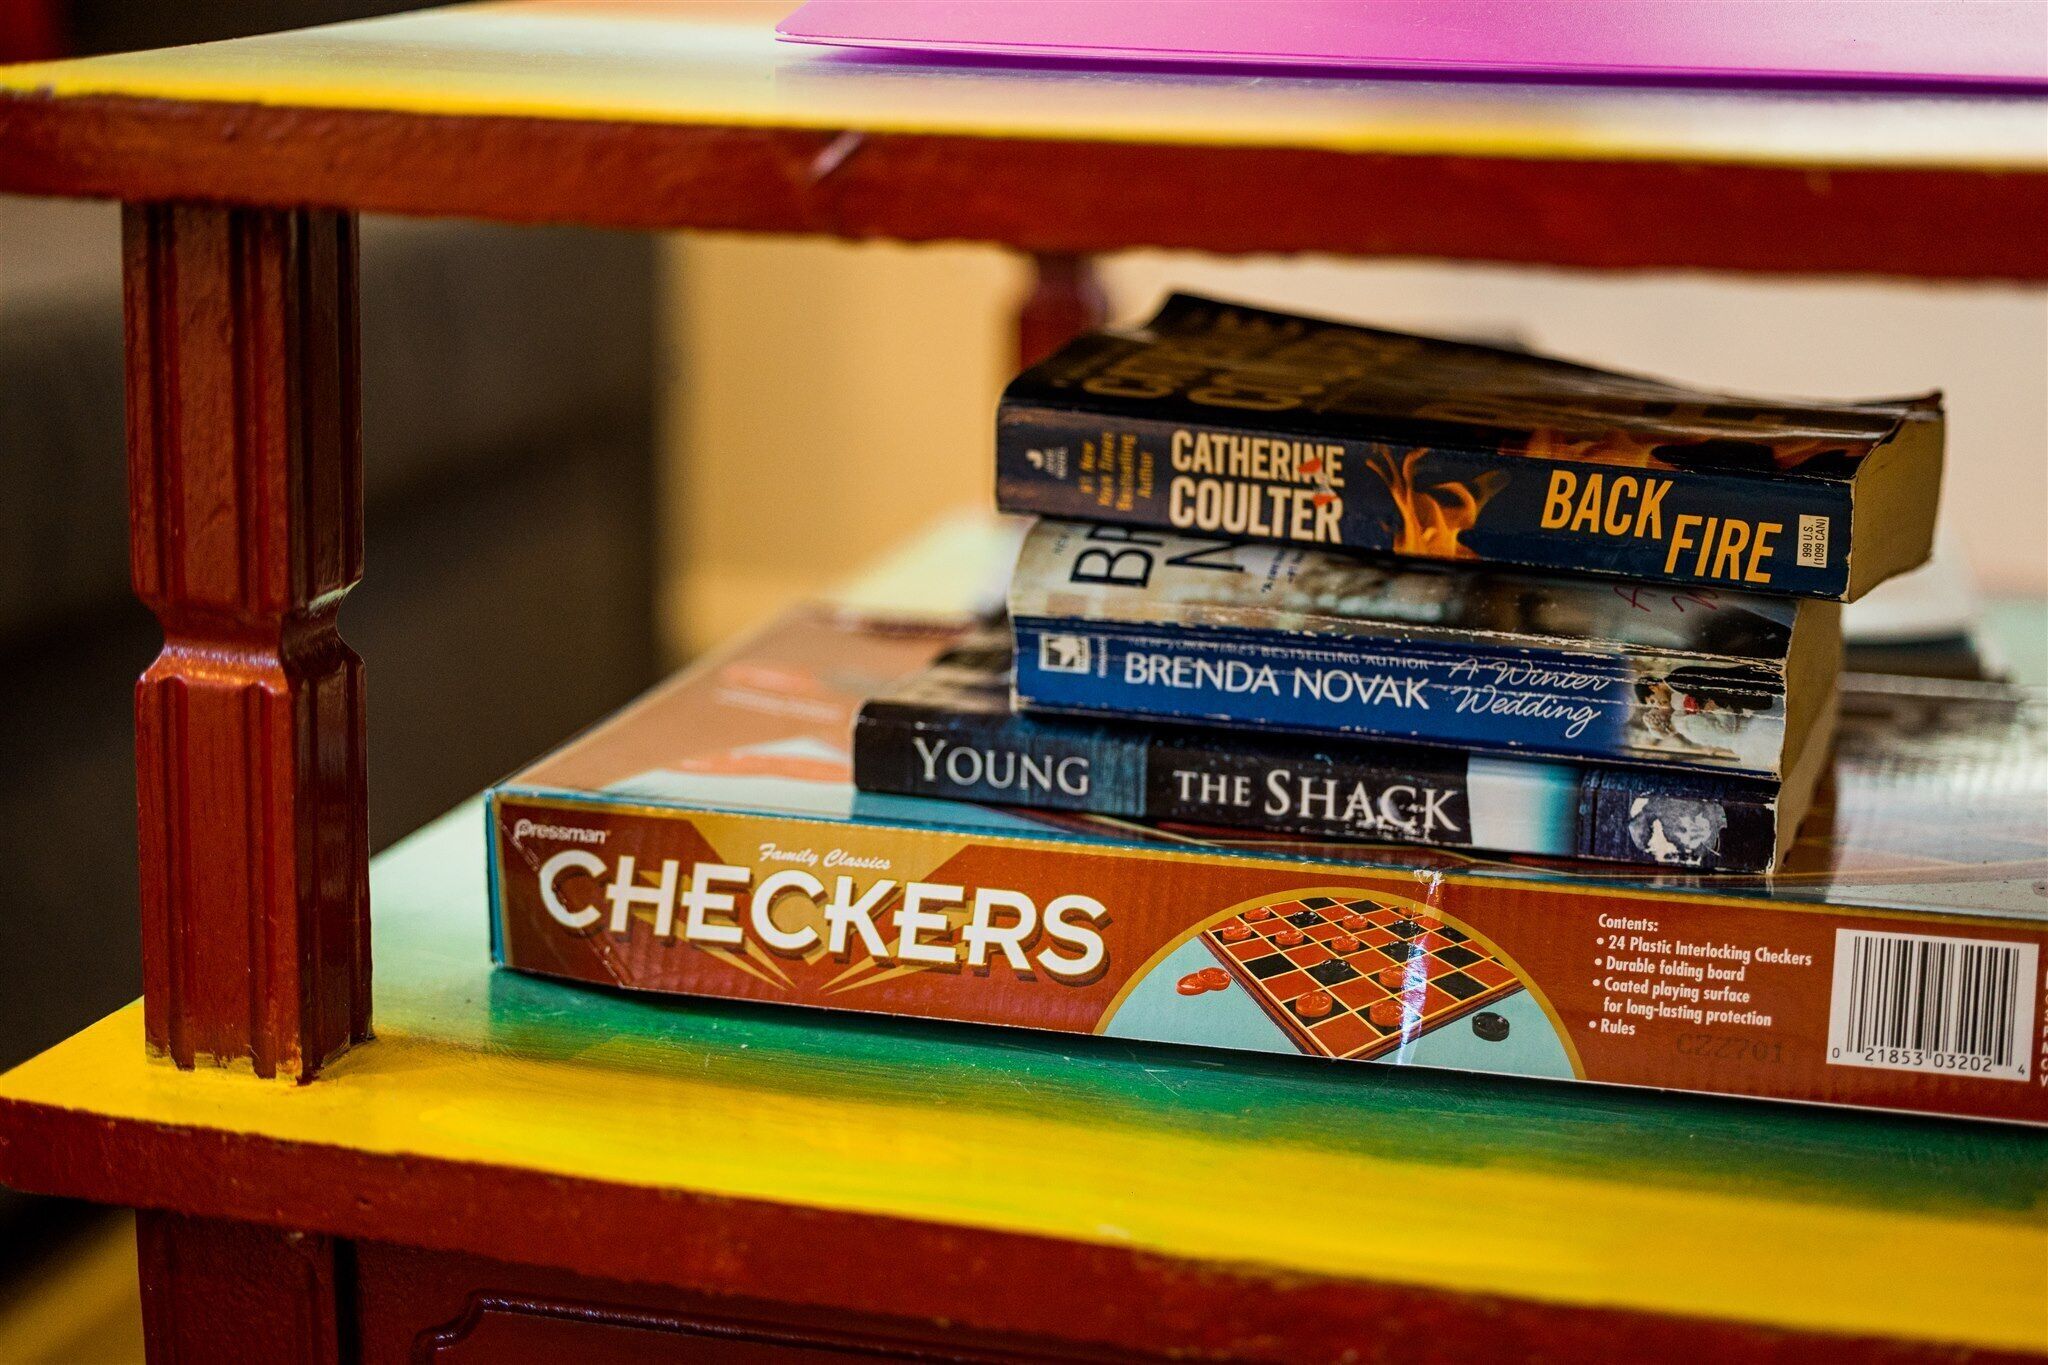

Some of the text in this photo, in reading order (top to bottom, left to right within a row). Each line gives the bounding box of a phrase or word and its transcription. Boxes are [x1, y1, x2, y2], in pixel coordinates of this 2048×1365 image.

[1171, 428, 1346, 488] CATHERINE
[1169, 475, 1344, 544] COULTER
[1541, 469, 1674, 539] BACK
[1664, 514, 1783, 584] FIRE
[1802, 525, 1813, 557] 999 U.S.
[1814, 518, 1827, 565] (1099 CAN)
[1261, 646, 1361, 666] BESTSELLING
[1366, 655, 1430, 671] AUTHOR
[1448, 658, 1610, 692] A Winter
[1125, 651, 1280, 697] BRENDA
[1293, 667, 1430, 710] NOVAK
[1451, 684, 1601, 739] Wedding
[912, 736, 1461, 832] YOUNG THE SHACK
[759, 843, 891, 870] Family Classics
[538, 850, 1107, 976] CHECKERS
[1598, 913, 1658, 932] Contents:
[1608, 935, 1812, 966] 24 Plastic Interlocking Checkers
[1606, 956, 1745, 982] Durable folding board
[1604, 976, 1750, 1003] Coated playing surface
[1600, 1019, 1636, 1036] Rules
[1604, 997, 1772, 1027] for long-lasting protection
[1832, 1047, 2026, 1075] 0 21853 03202 4
